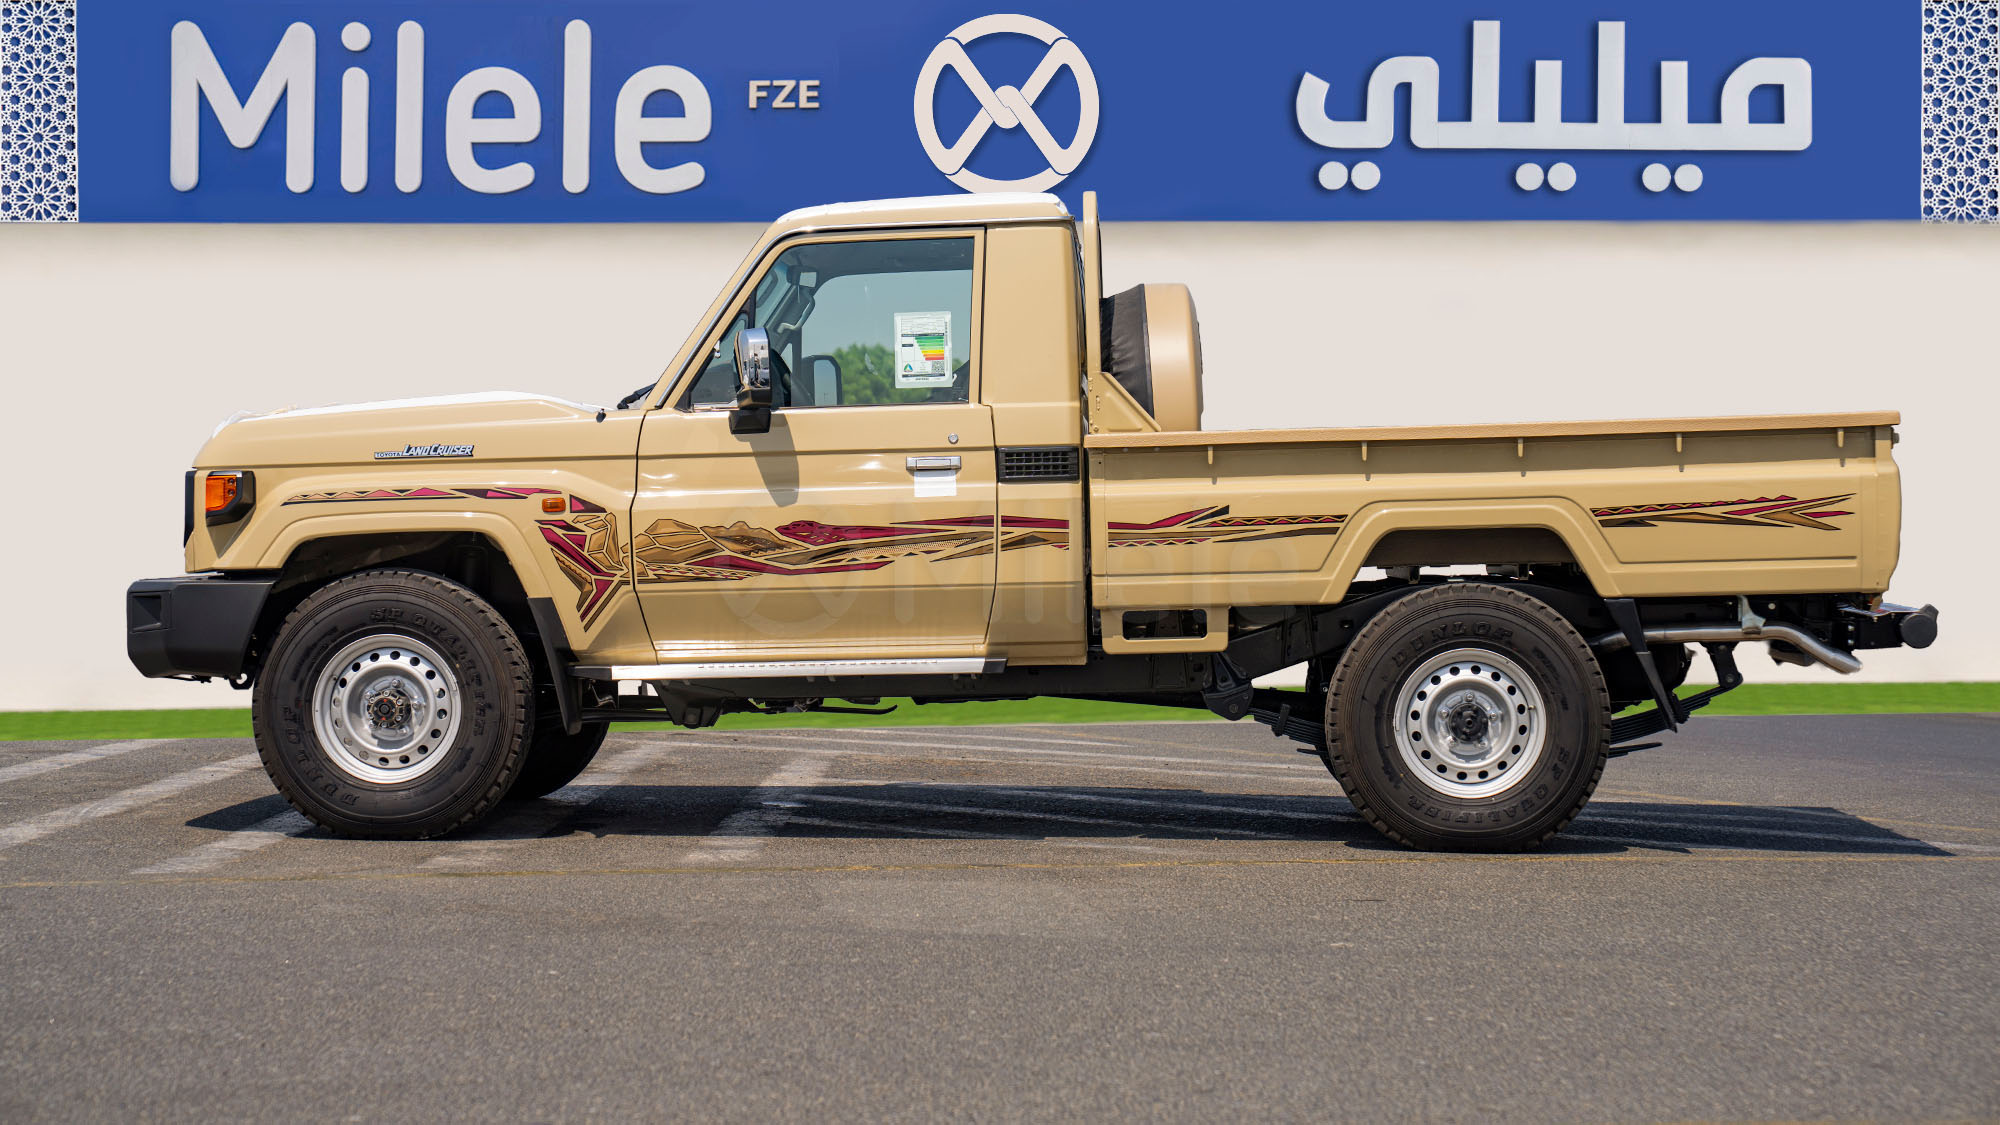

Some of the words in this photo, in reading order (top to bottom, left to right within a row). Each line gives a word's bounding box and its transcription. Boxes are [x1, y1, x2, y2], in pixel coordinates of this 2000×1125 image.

[170, 19, 712, 194] Milele
[748, 79, 821, 110] FZE
[1296, 20, 1813, 192] ميليلي
[1391, 621, 1514, 667] DUNLOP
